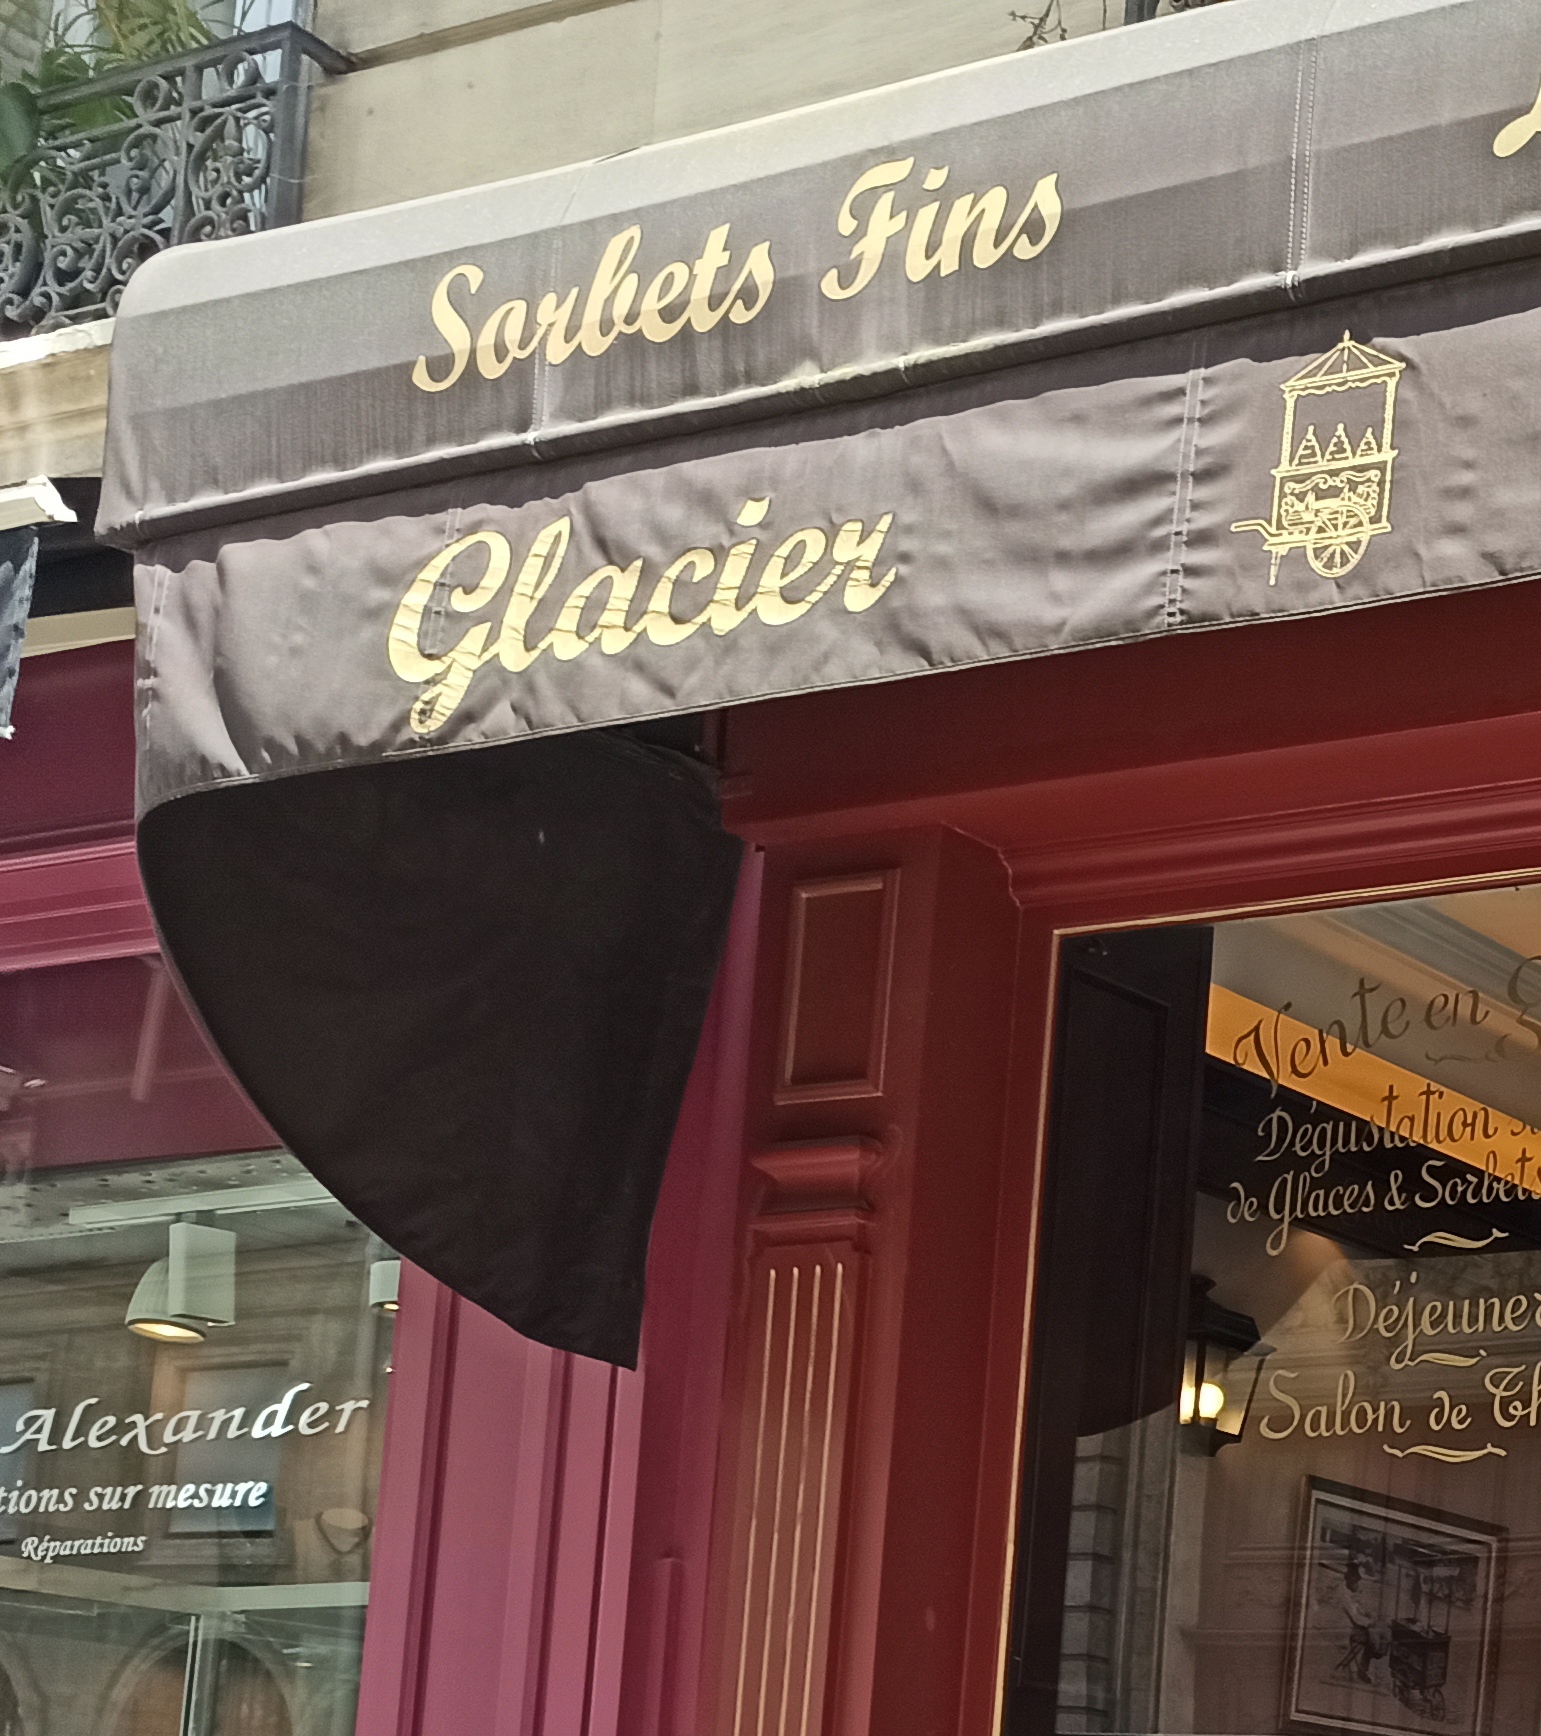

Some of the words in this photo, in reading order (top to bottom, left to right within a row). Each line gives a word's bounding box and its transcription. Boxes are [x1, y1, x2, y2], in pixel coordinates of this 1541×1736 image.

[411, 223, 774, 394] Sorbets
[819, 157, 1064, 302] Fins
[387, 497, 898, 735] Glacier
[1233, 976, 1411, 1098] Vente
[1423, 988, 1492, 1034] en
[1256, 1081, 1500, 1176] Dégustation
[1226, 1181, 1261, 1223] de
[1383, 1170, 1409, 1211] &
[0, 1381, 371, 1455] Alexander
[1259, 1369, 1411, 1441] Salon
[1429, 1390, 1472, 1430] de
[83, 1484, 143, 1511] sur
[148, 1479, 268, 1509] mesure
[20, 1531, 146, 1564] Réparations
